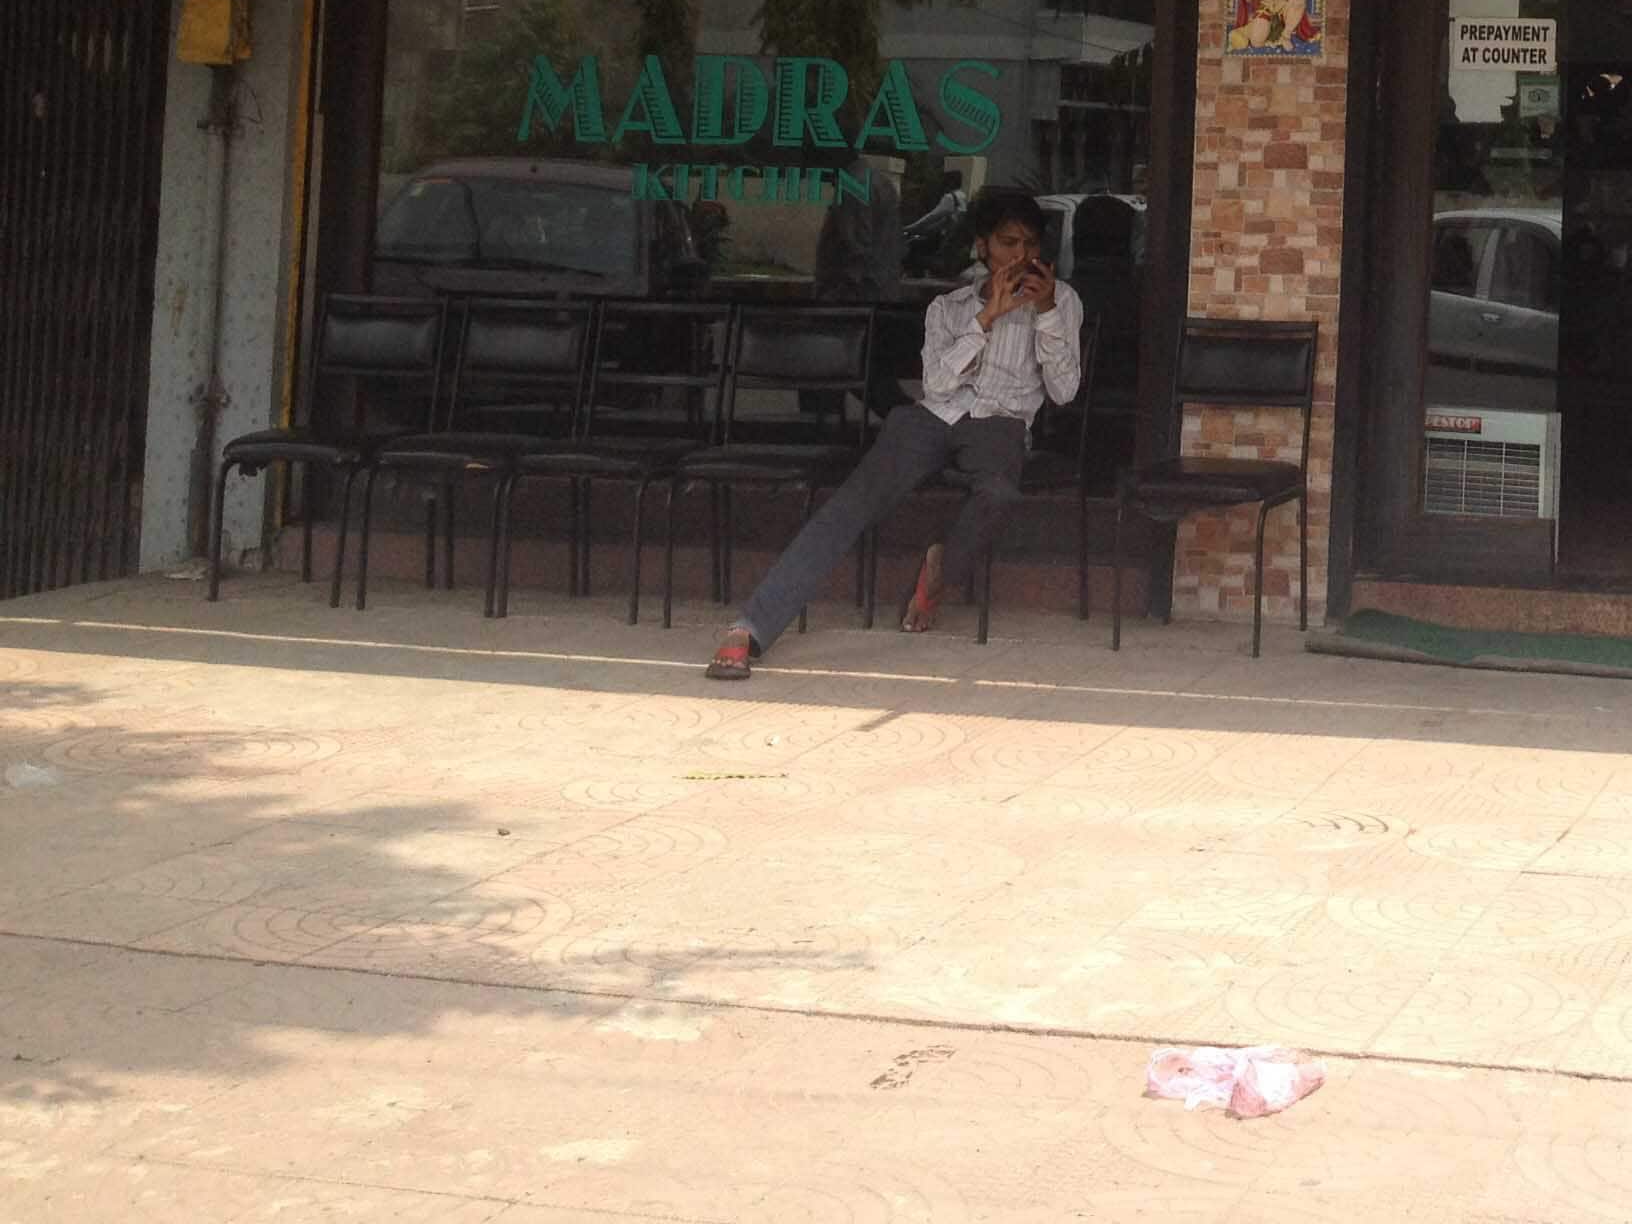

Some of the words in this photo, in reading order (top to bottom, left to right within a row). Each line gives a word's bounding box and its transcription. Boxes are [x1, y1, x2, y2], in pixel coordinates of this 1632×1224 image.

[1460, 24, 1550, 43] PREPAYMENT
[1462, 47, 1479, 64] AT
[1482, 47, 1548, 65] COUNTER
[517, 54, 1002, 155] MADRAS
[632, 162, 872, 206] KITCHEN
